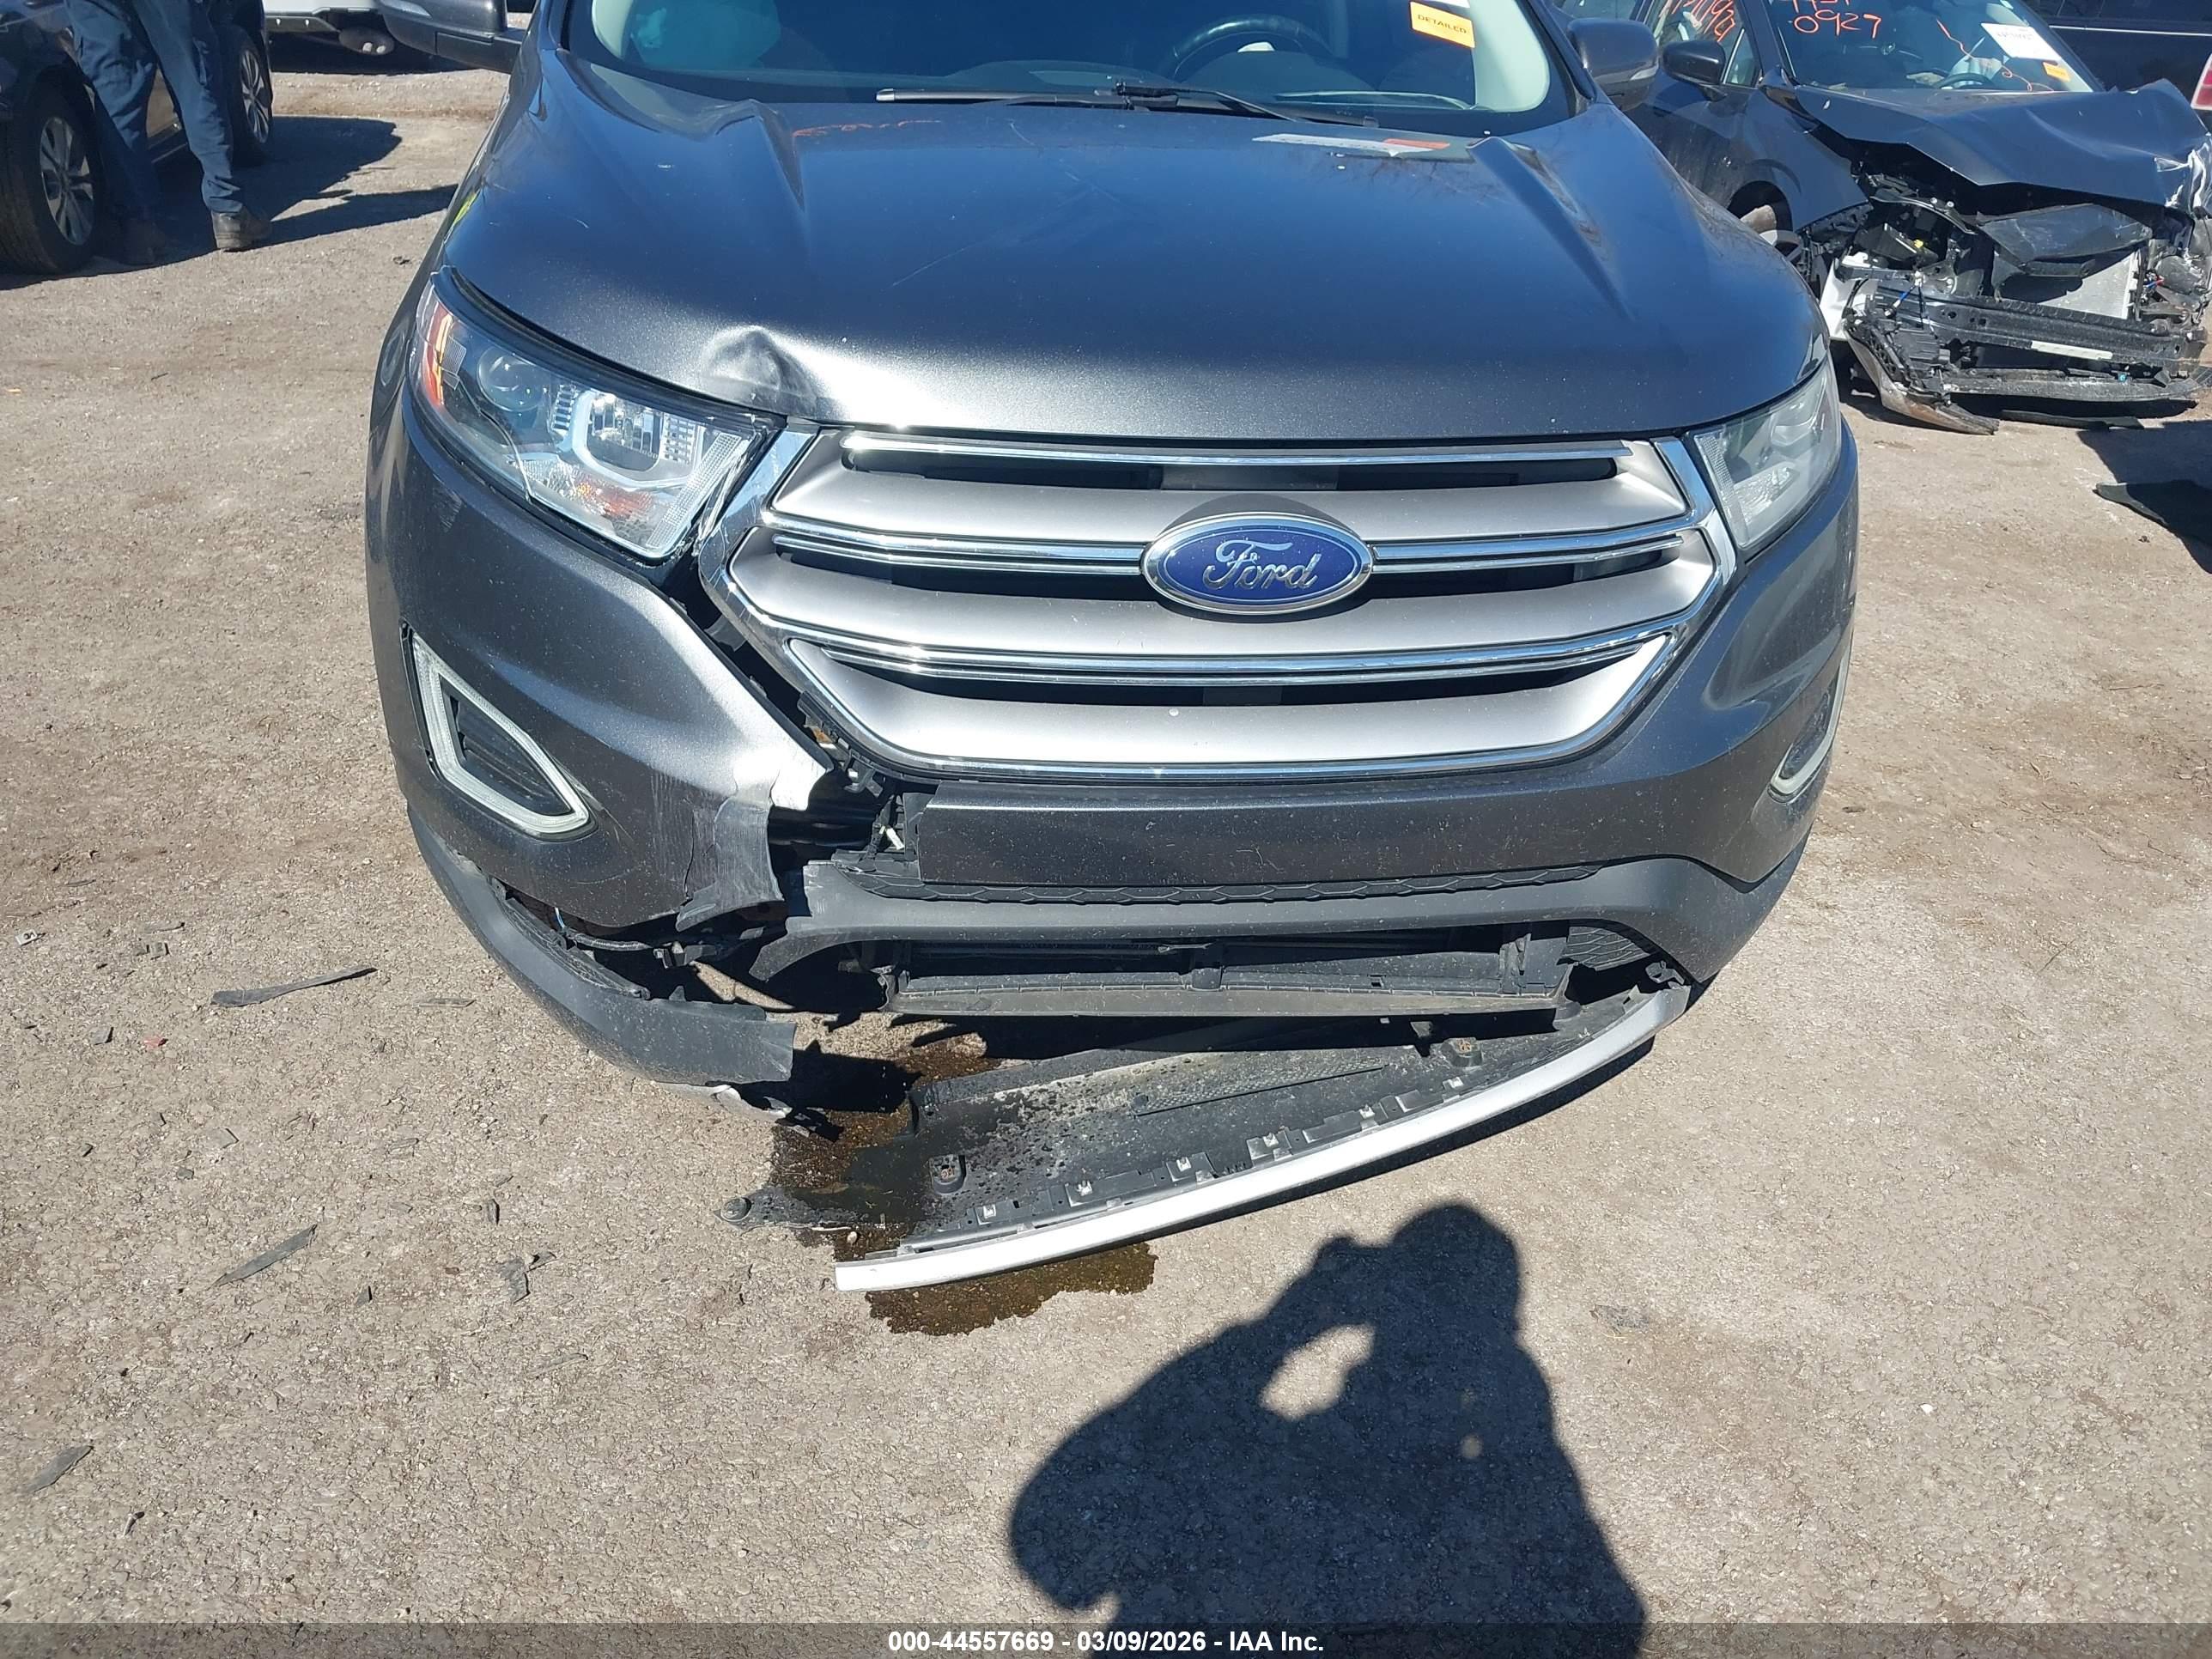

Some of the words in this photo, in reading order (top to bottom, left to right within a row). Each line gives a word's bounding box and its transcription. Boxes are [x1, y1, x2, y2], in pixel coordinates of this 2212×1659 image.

[1417, 14, 1468, 33] DETAILED
[1793, 9, 1882, 39] 0927
[1202, 539, 1322, 591] Ford
